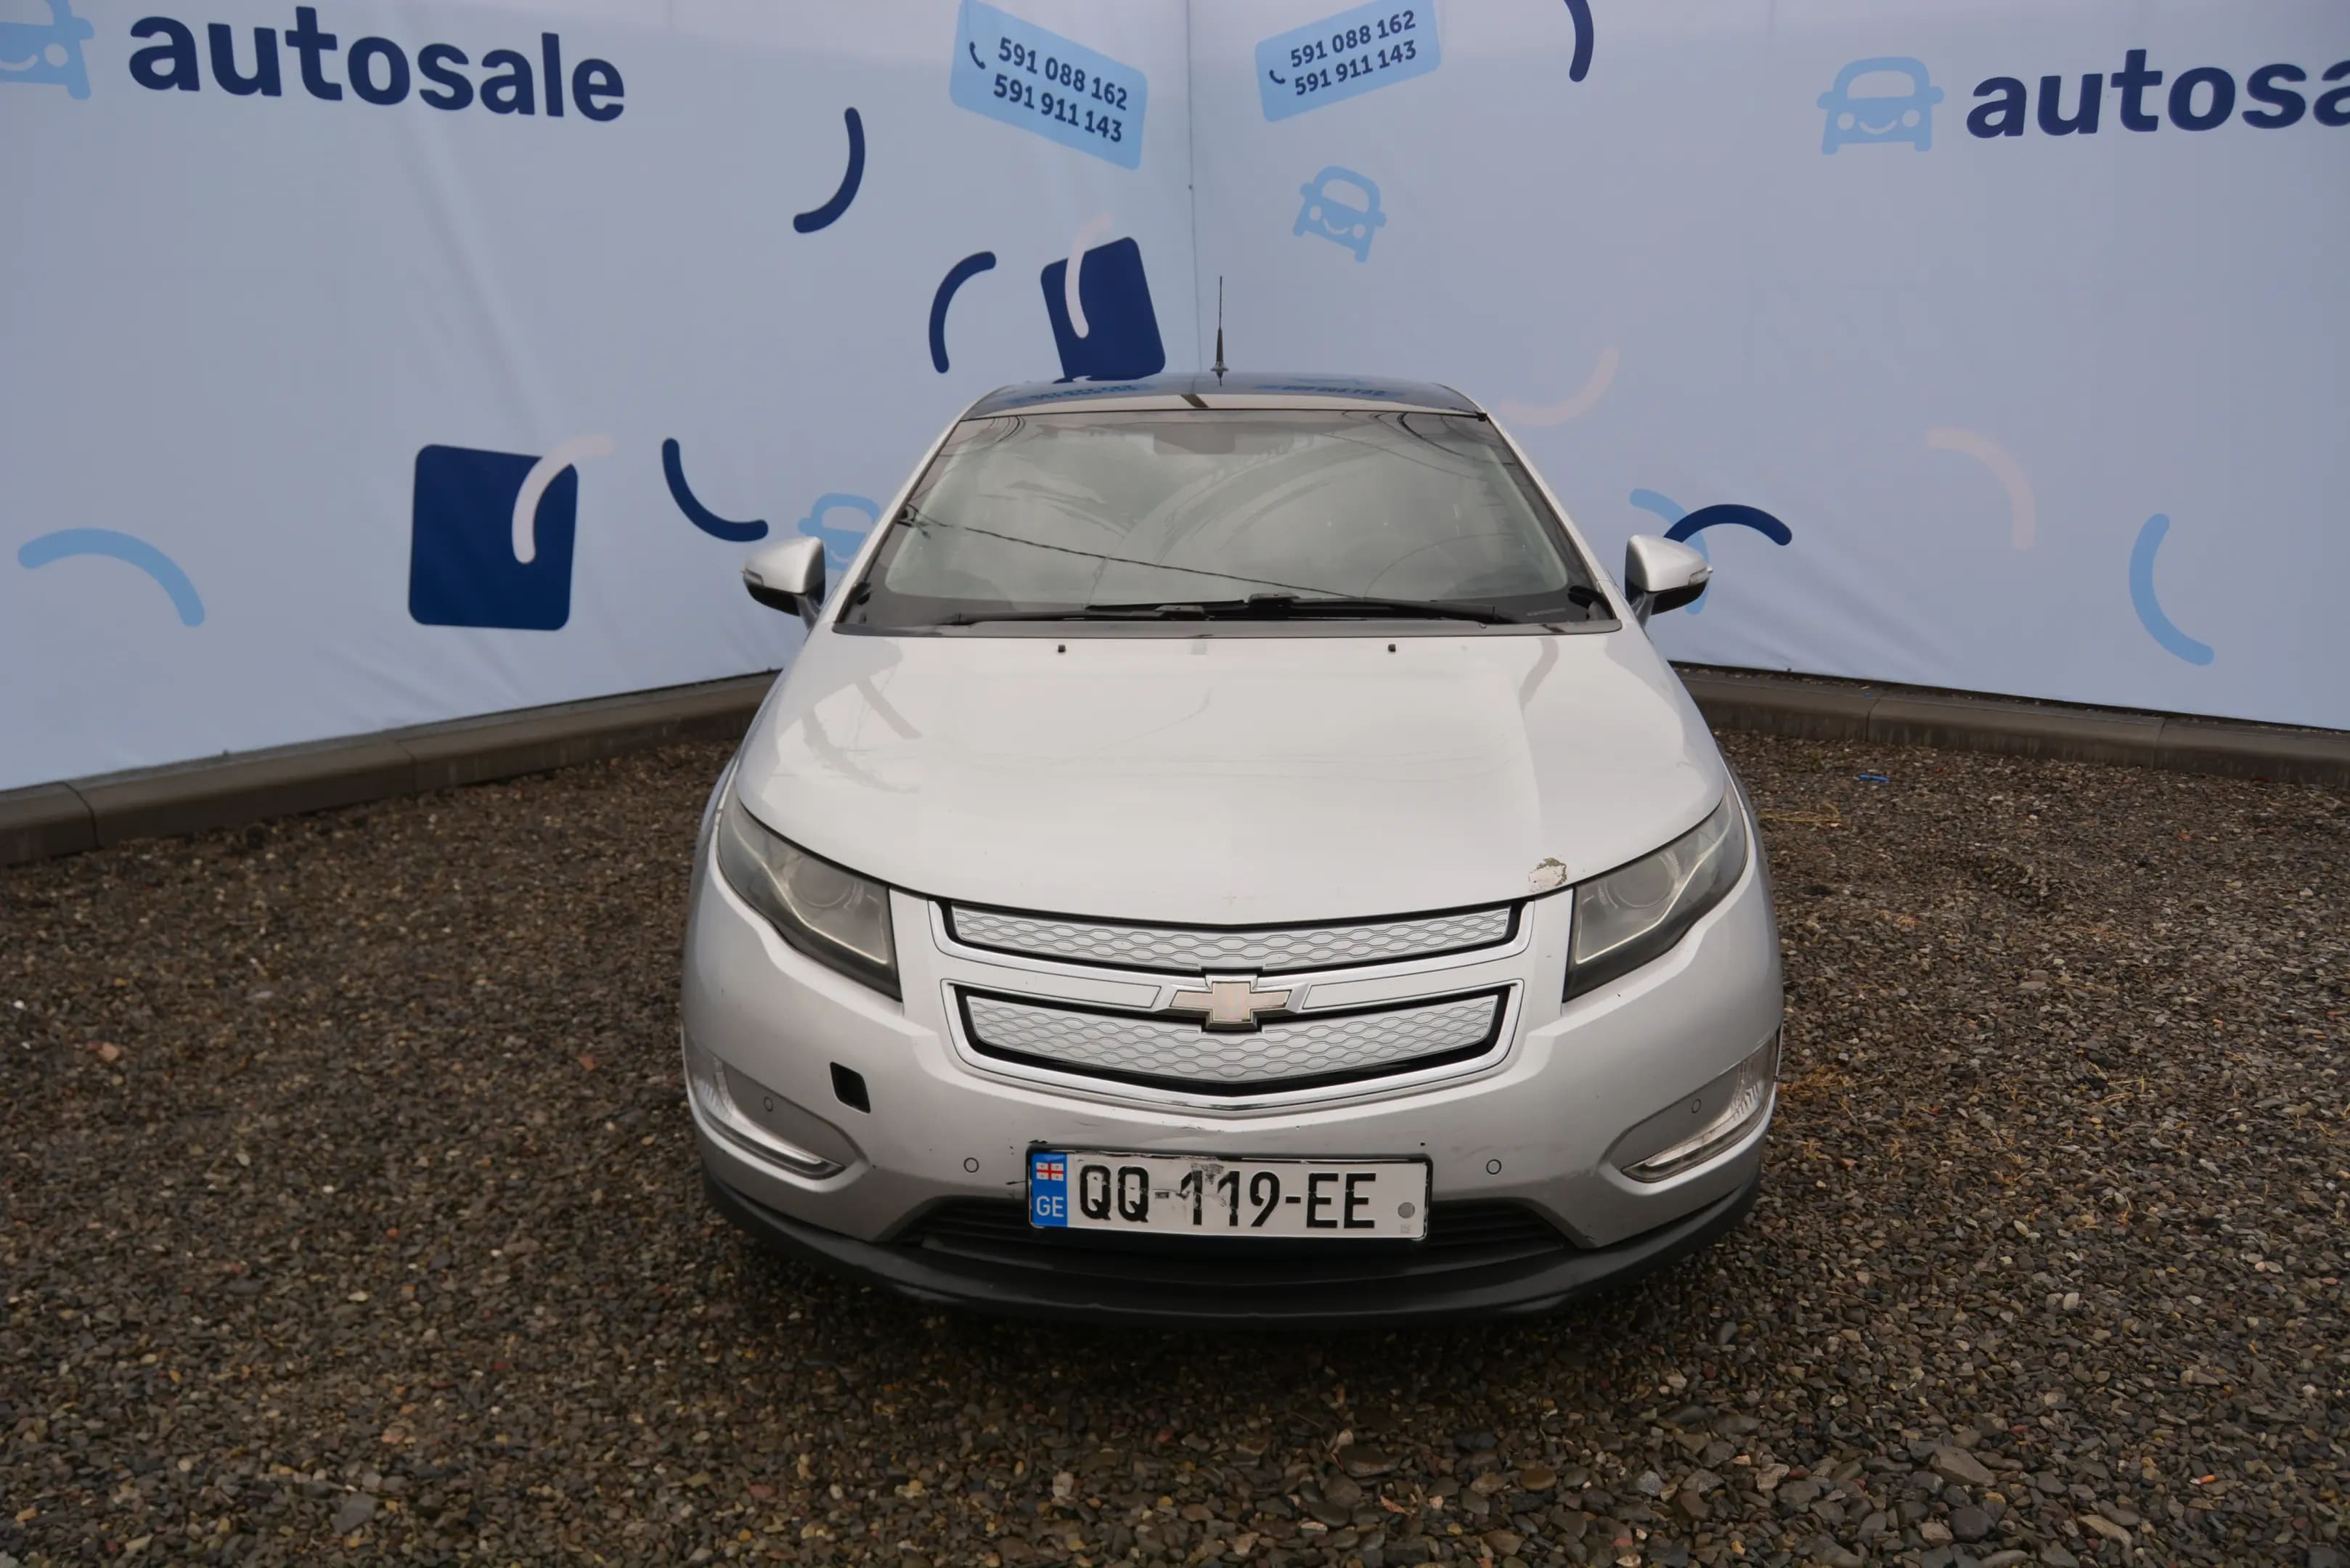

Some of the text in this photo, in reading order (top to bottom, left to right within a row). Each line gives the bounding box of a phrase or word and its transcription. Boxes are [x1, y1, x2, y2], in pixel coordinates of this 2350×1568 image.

[128, 5, 624, 122] autosale
[1291, 10, 1416, 68] 591 088 162
[1294, 40, 1416, 95] 591 911 143
[998, 37, 1127, 111] 591 088 162
[993, 73, 1122, 142] 591 911 143
[1036, 1195, 1064, 1217] GE
[1079, 1164, 1376, 1230] QQ-119-EE
